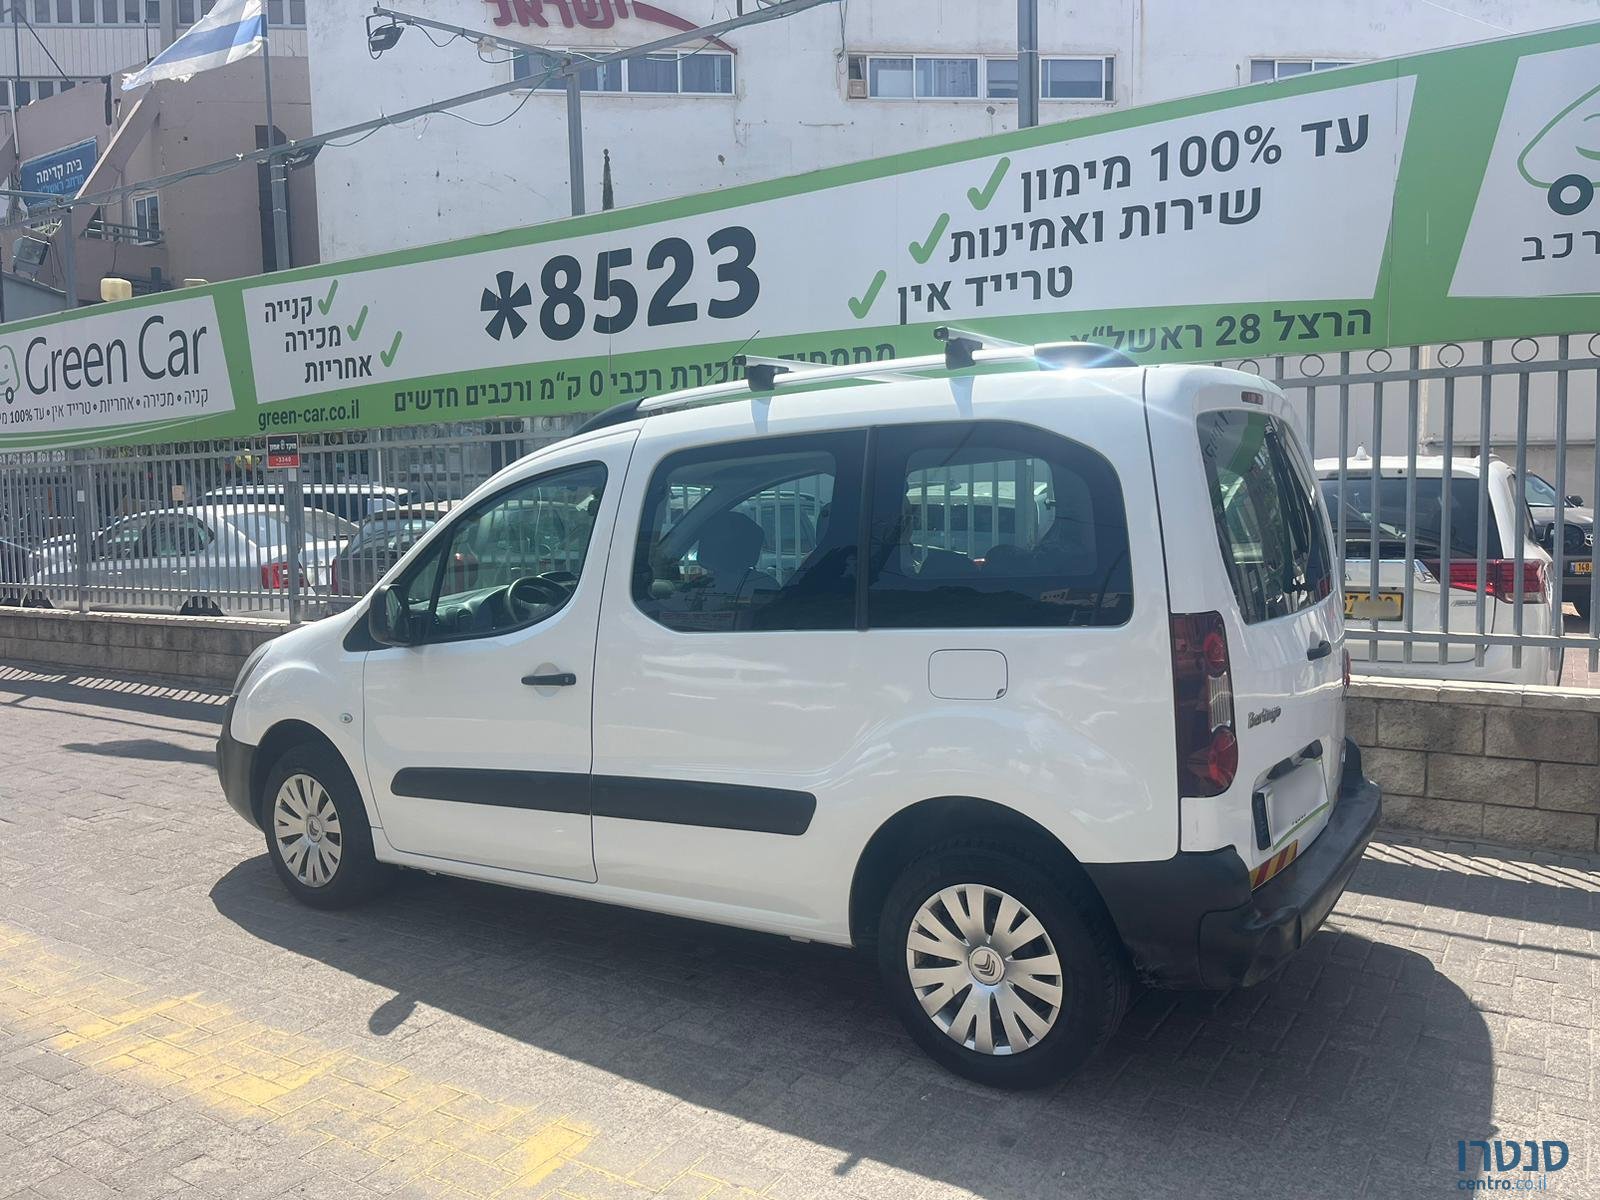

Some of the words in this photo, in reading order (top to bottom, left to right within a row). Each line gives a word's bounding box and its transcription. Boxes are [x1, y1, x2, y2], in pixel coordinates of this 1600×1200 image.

[1301, 113, 1369, 157] עד
[66, 158, 83, 174] בית
[1150, 125, 1282, 183] 100%
[36, 163, 64, 184] קדימה
[1020, 155, 1131, 213] מימון
[1119, 186, 1262, 240] שירות
[949, 210, 1105, 264] ואמינות
[964, 264, 1073, 308] טרייד
[264, 296, 313, 325] קנייה
[897, 280, 952, 326] אין
[285, 325, 342, 353] מכירה
[1214, 313, 1262, 347] 28
[1273, 308, 1372, 342] הרצל
[25, 336, 128, 396] Green
[138, 315, 207, 380] Car
[304, 354, 373, 384] אחריות
[466, 380, 532, 406] ורכבים
[589, 369, 604, 397] 0
[610, 368, 662, 395] רכבי
[66, 401, 92, 417] טרייד
[99, 396, 135, 414] אחריות
[143, 392, 175, 409] מכירה
[184, 388, 208, 408] קניה
[395, 387, 459, 412] חדשים
[10, 408, 33, 424] 100%
[34, 407, 45, 421] עד
[52, 404, 65, 422] אין
[258, 399, 360, 430] green-car.co.il
